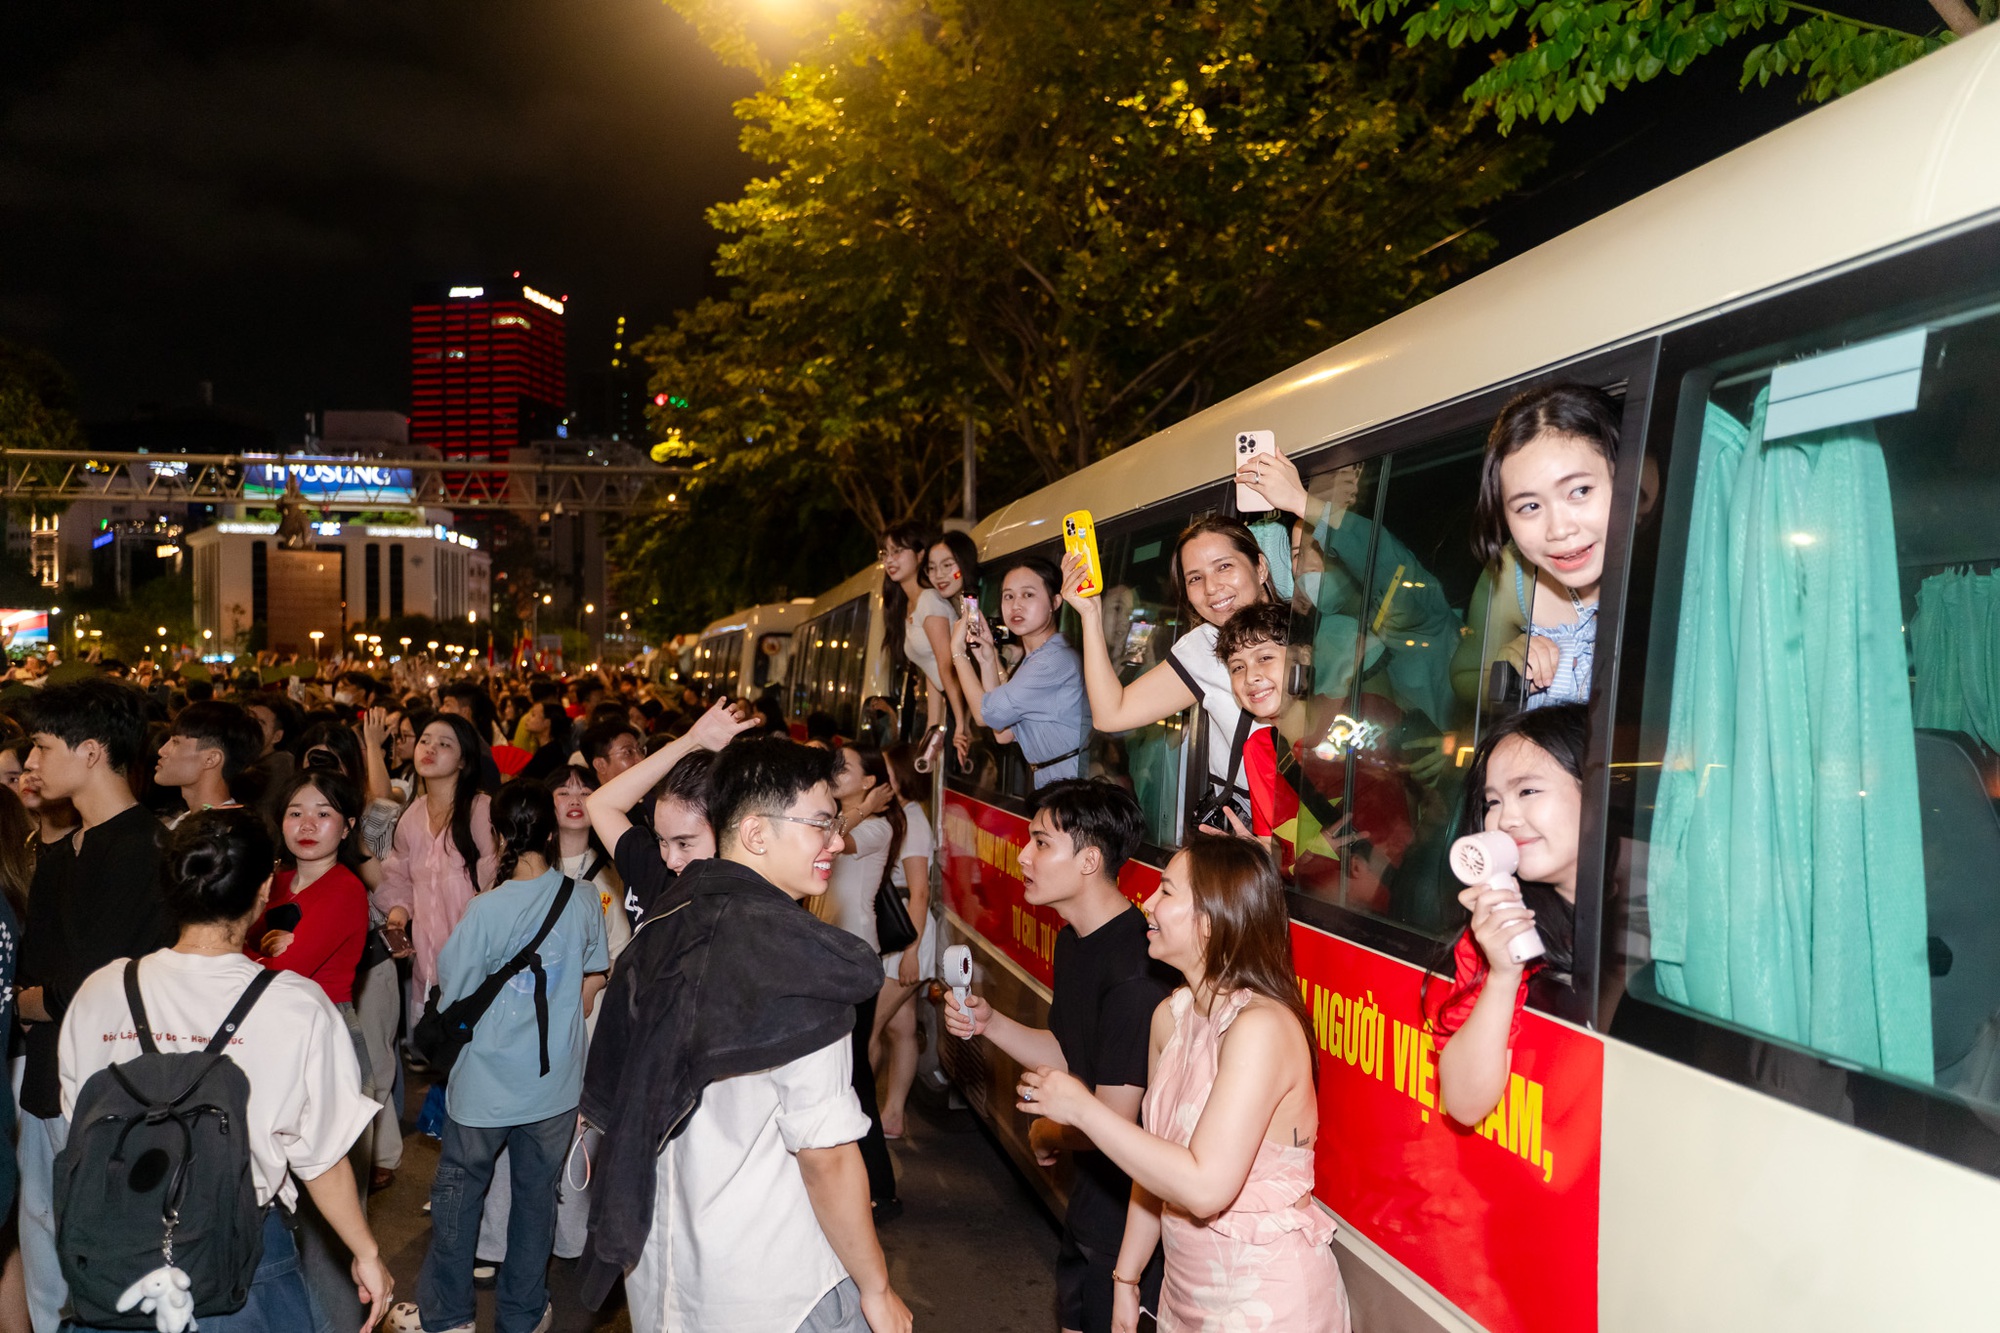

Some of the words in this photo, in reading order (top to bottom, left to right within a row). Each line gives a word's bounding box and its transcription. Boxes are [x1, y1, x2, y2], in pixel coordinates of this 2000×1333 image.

[1313, 983, 1385, 1082] NGƯỜI
[1393, 1019, 1447, 1124] VIỆ
[1474, 1072, 1553, 1183] AM,
